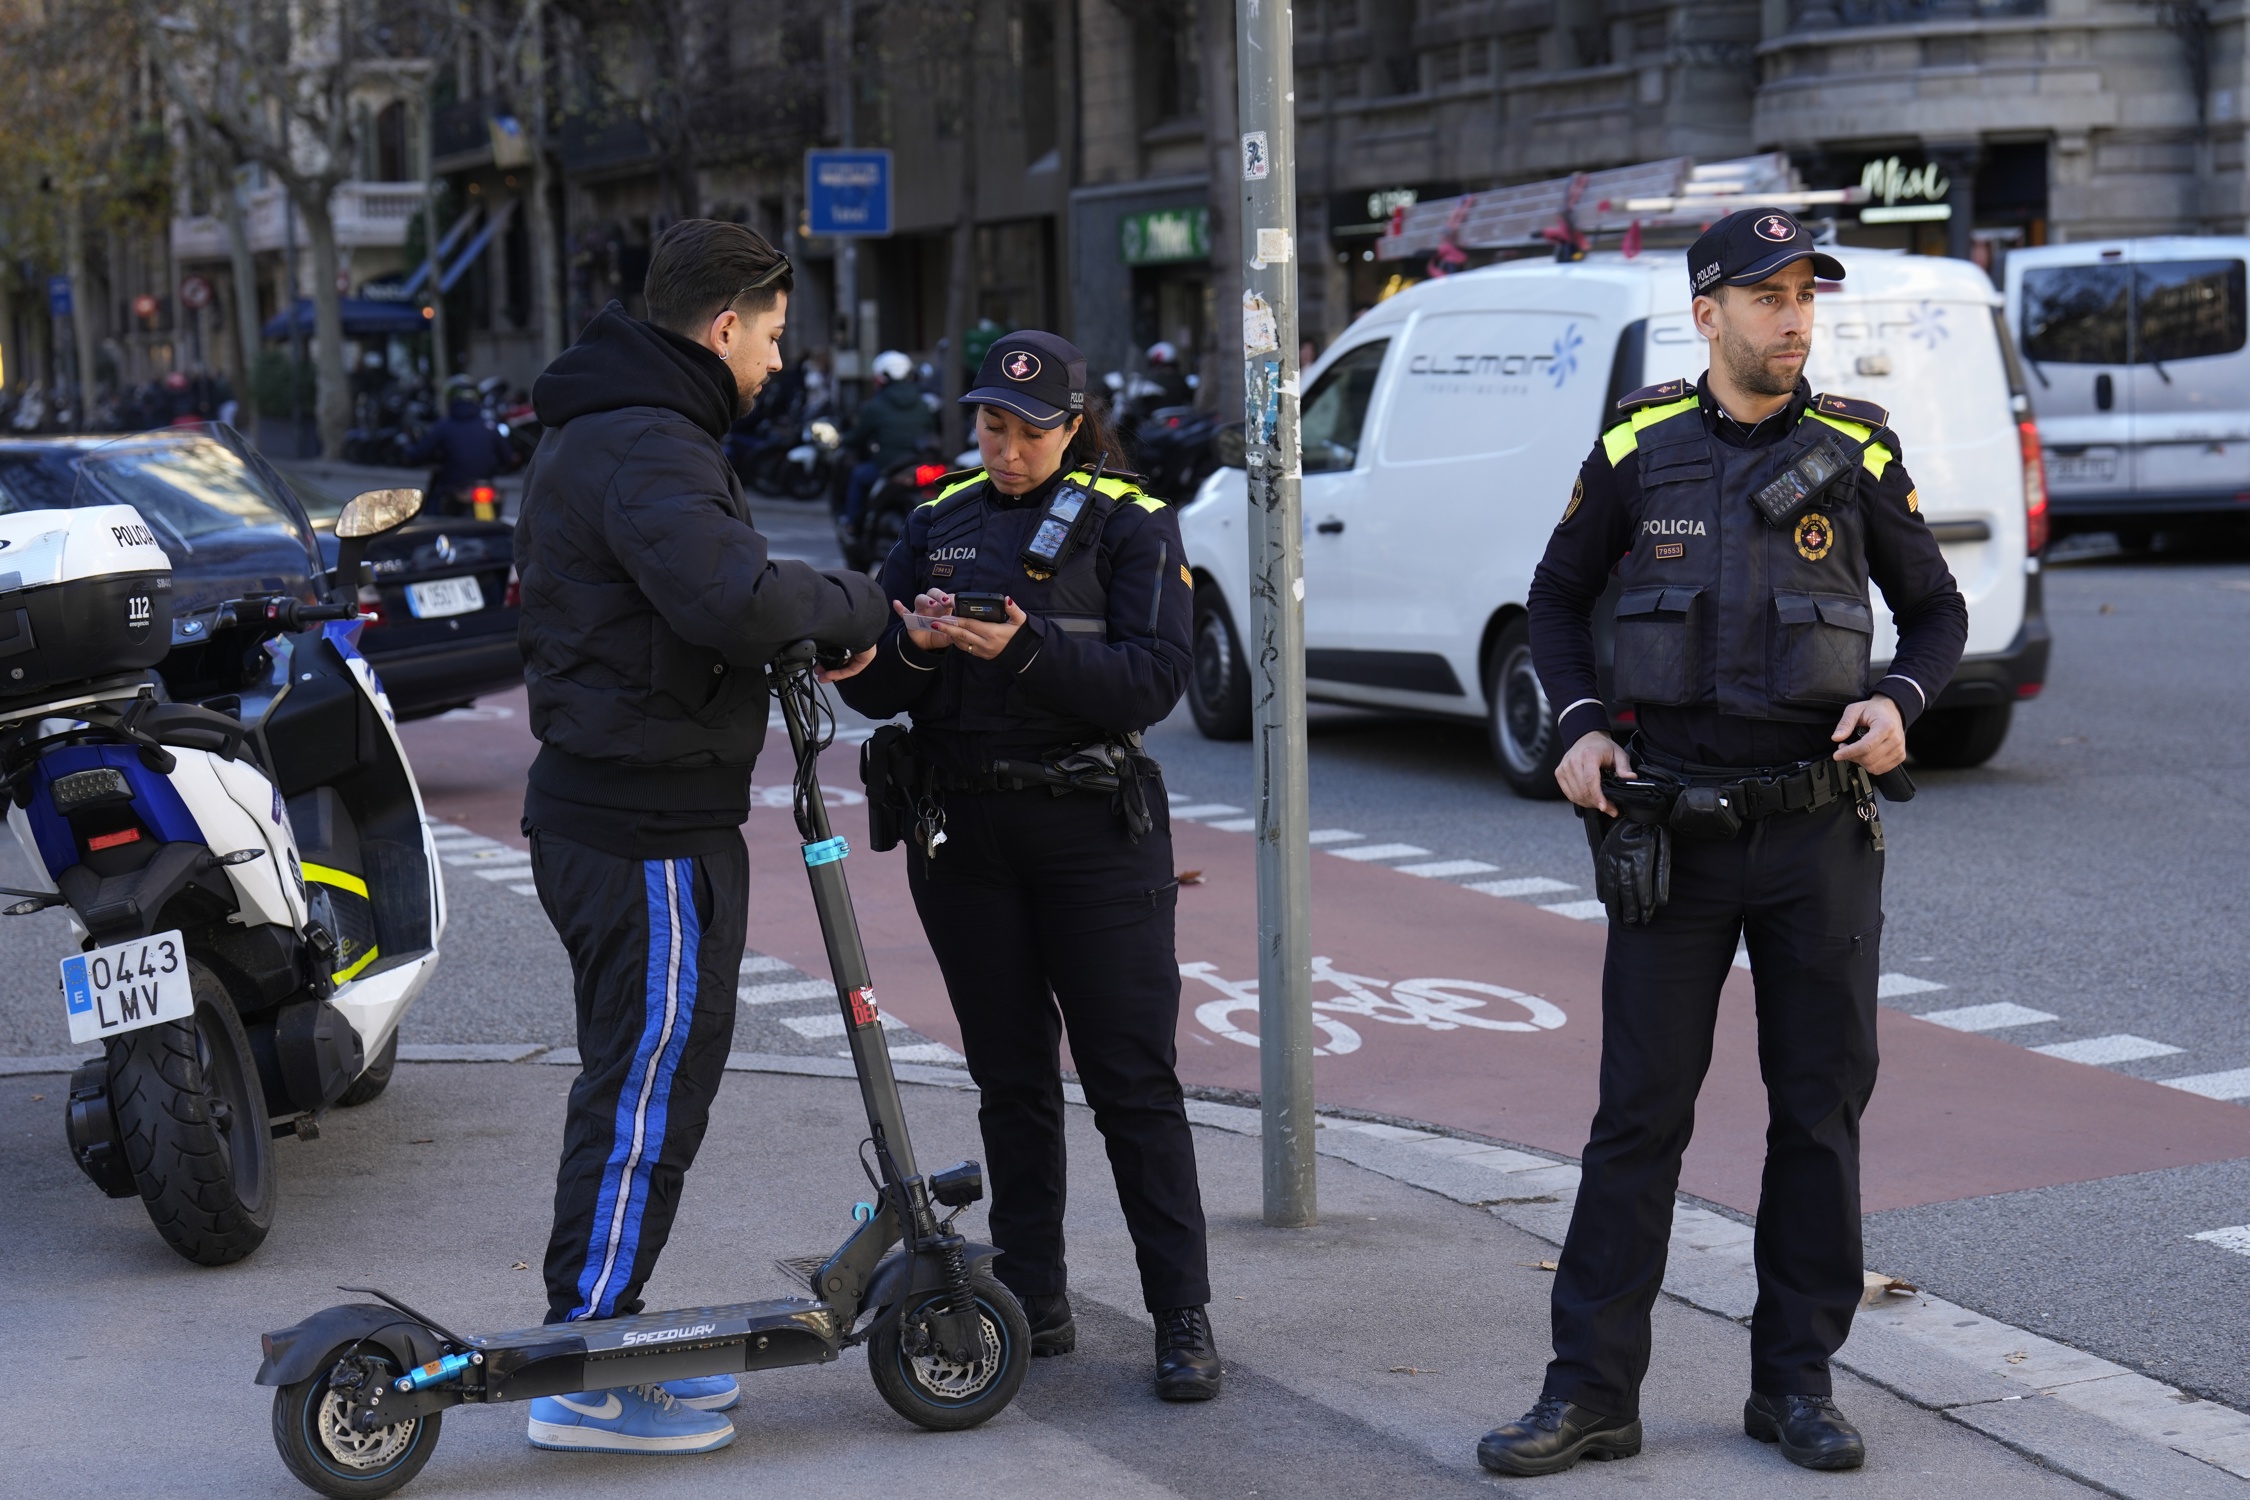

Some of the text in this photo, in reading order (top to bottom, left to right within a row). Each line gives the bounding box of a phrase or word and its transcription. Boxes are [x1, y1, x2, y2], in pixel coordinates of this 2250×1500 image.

[1696, 261, 1721, 284] POLICIA
[111, 525, 157, 548] POLICIA
[1642, 519, 1706, 536] POLICIA
[929, 547, 977, 561] OLICIA
[1659, 546, 1680, 555] 79553
[129, 596, 150, 619] 112
[92, 940, 178, 990] 0443
[74, 991, 85, 1004] E
[97, 981, 158, 1029] LMV
[621, 1323, 716, 1347] SPEEDWAY
